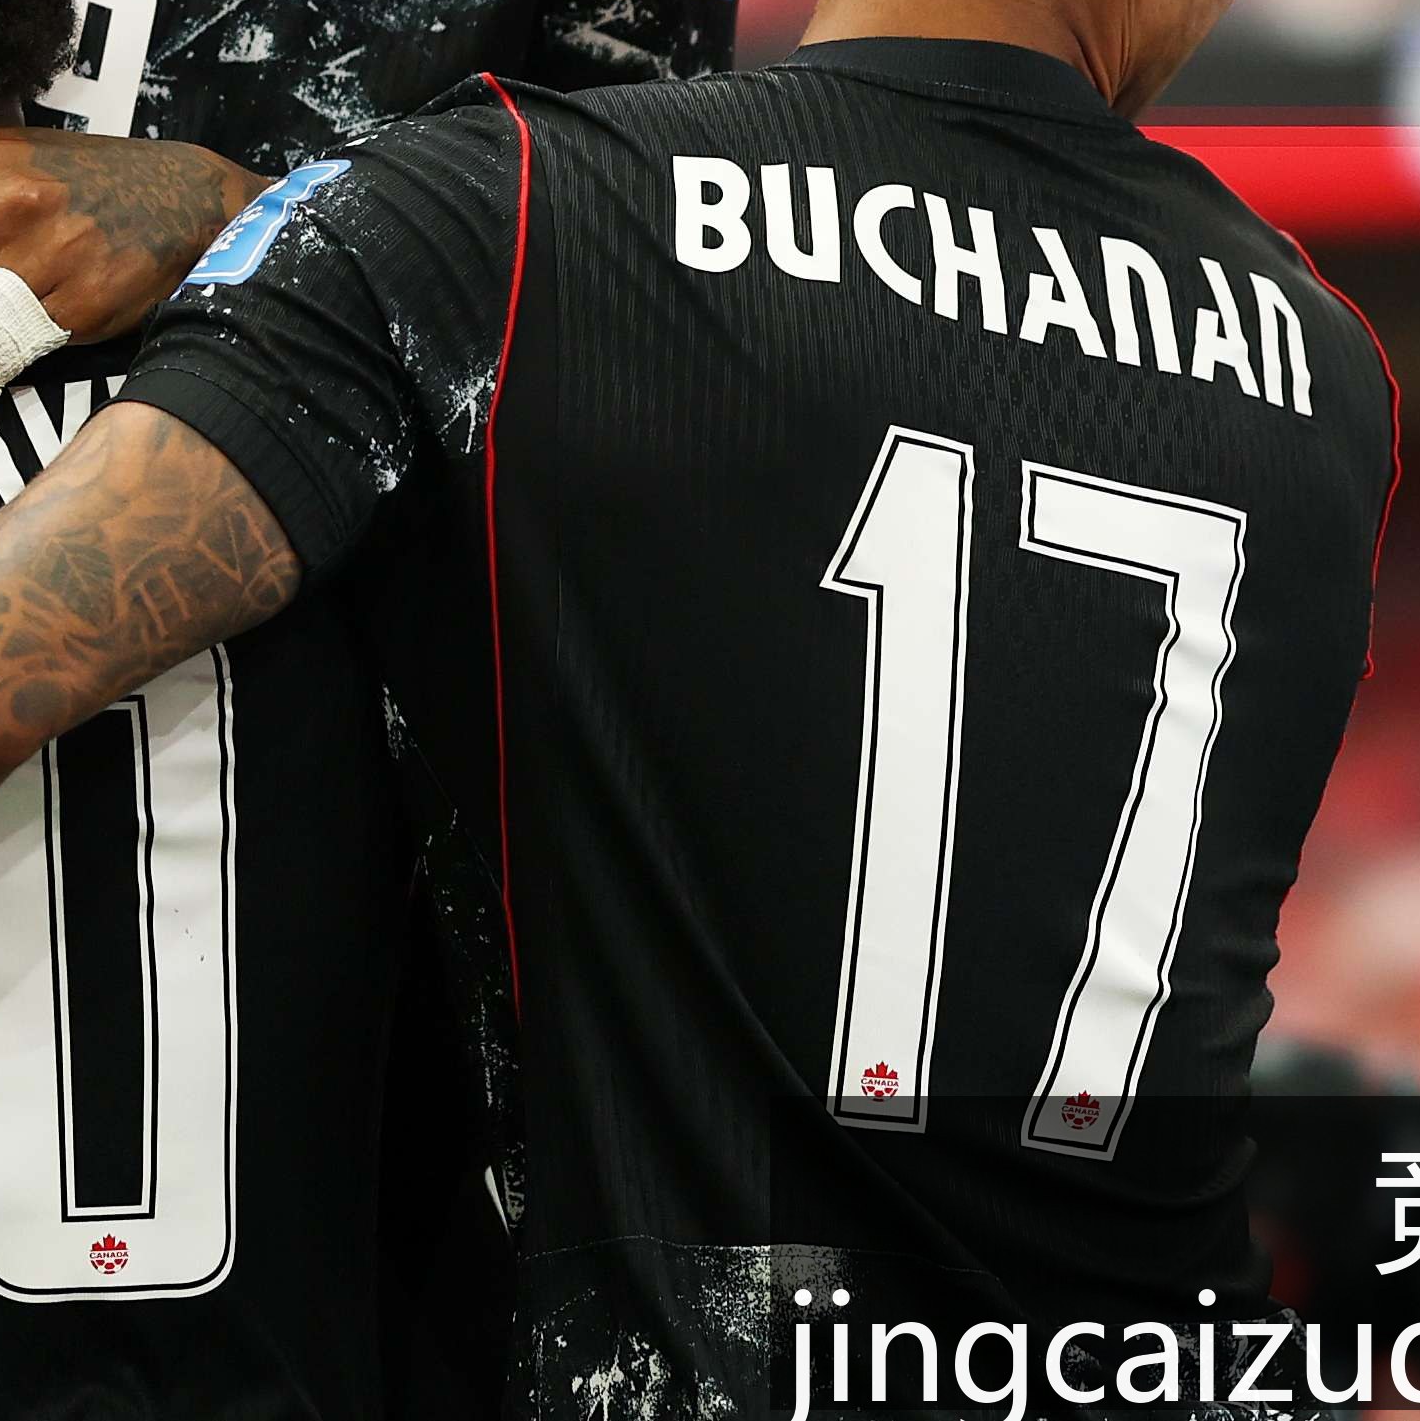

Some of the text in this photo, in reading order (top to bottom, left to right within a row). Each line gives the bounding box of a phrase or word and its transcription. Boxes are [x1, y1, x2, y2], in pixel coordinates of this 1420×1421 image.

[672, 155, 1313, 417] BUCHANAN
[818, 424, 1248, 1162] 17
[861, 1077, 900, 1088] CANADA
[1061, 1105, 1101, 1117] CANADA
[89, 1251, 130, 1260] CANADA
